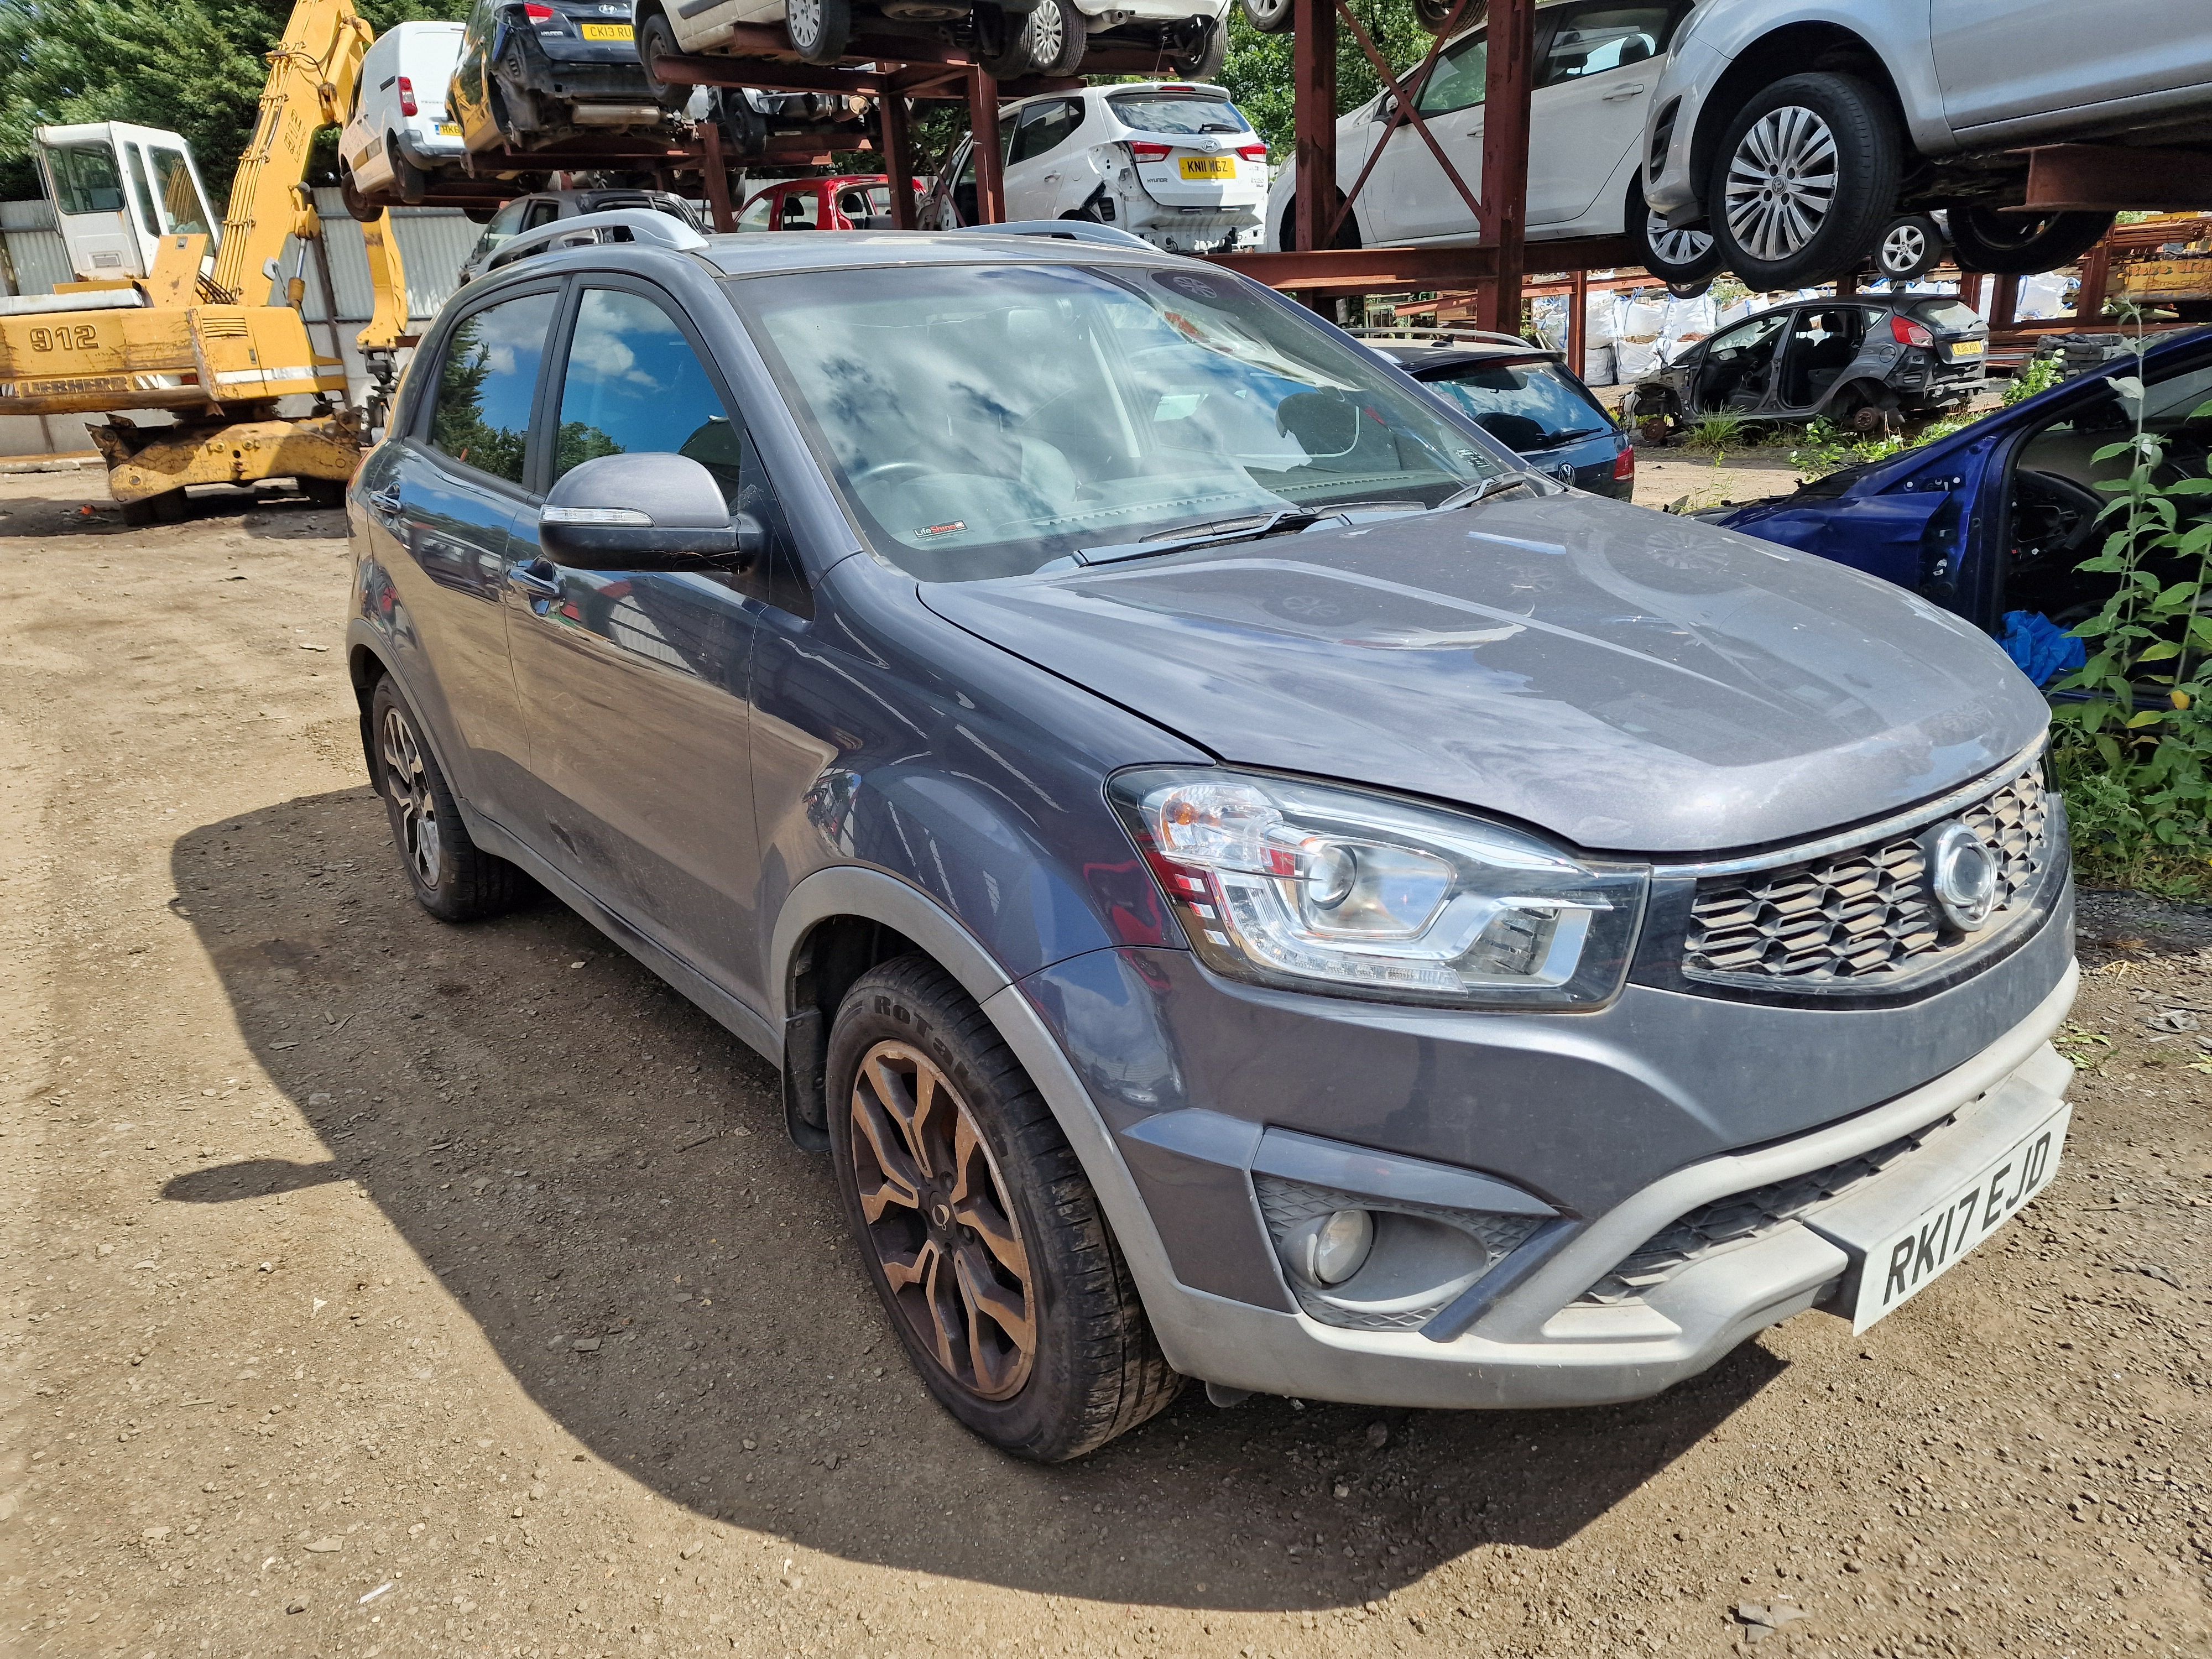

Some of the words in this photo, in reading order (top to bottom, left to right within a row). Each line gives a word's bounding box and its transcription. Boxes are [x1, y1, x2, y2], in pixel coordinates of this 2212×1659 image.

[589, 27, 615, 36] CK13
[284, 108, 302, 154] 912
[1187, 160, 1207, 173] KN11
[29, 323, 100, 352] 912
[1882, 1186, 1981, 1306] RK17
[1981, 1131, 2052, 1233] EJD
